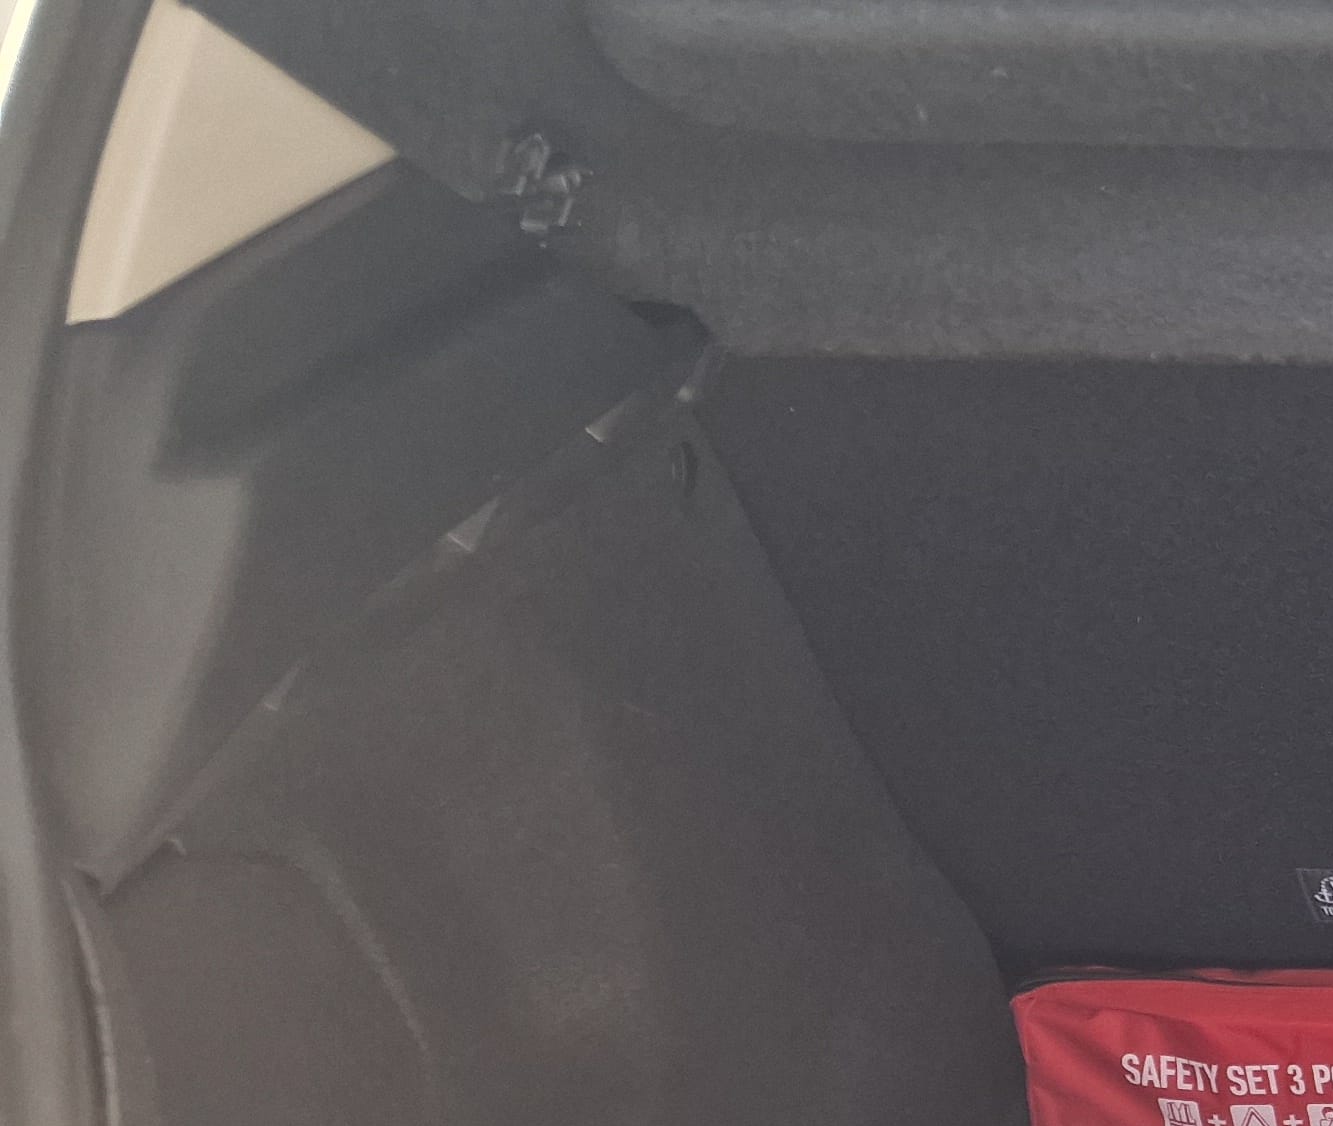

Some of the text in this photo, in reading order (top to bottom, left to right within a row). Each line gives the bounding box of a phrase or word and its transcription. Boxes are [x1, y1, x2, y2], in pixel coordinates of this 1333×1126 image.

[1121, 1053, 1218, 1093] SAFETY
[1226, 1065, 1279, 1096] SET
[1287, 1065, 1306, 1095] 3
